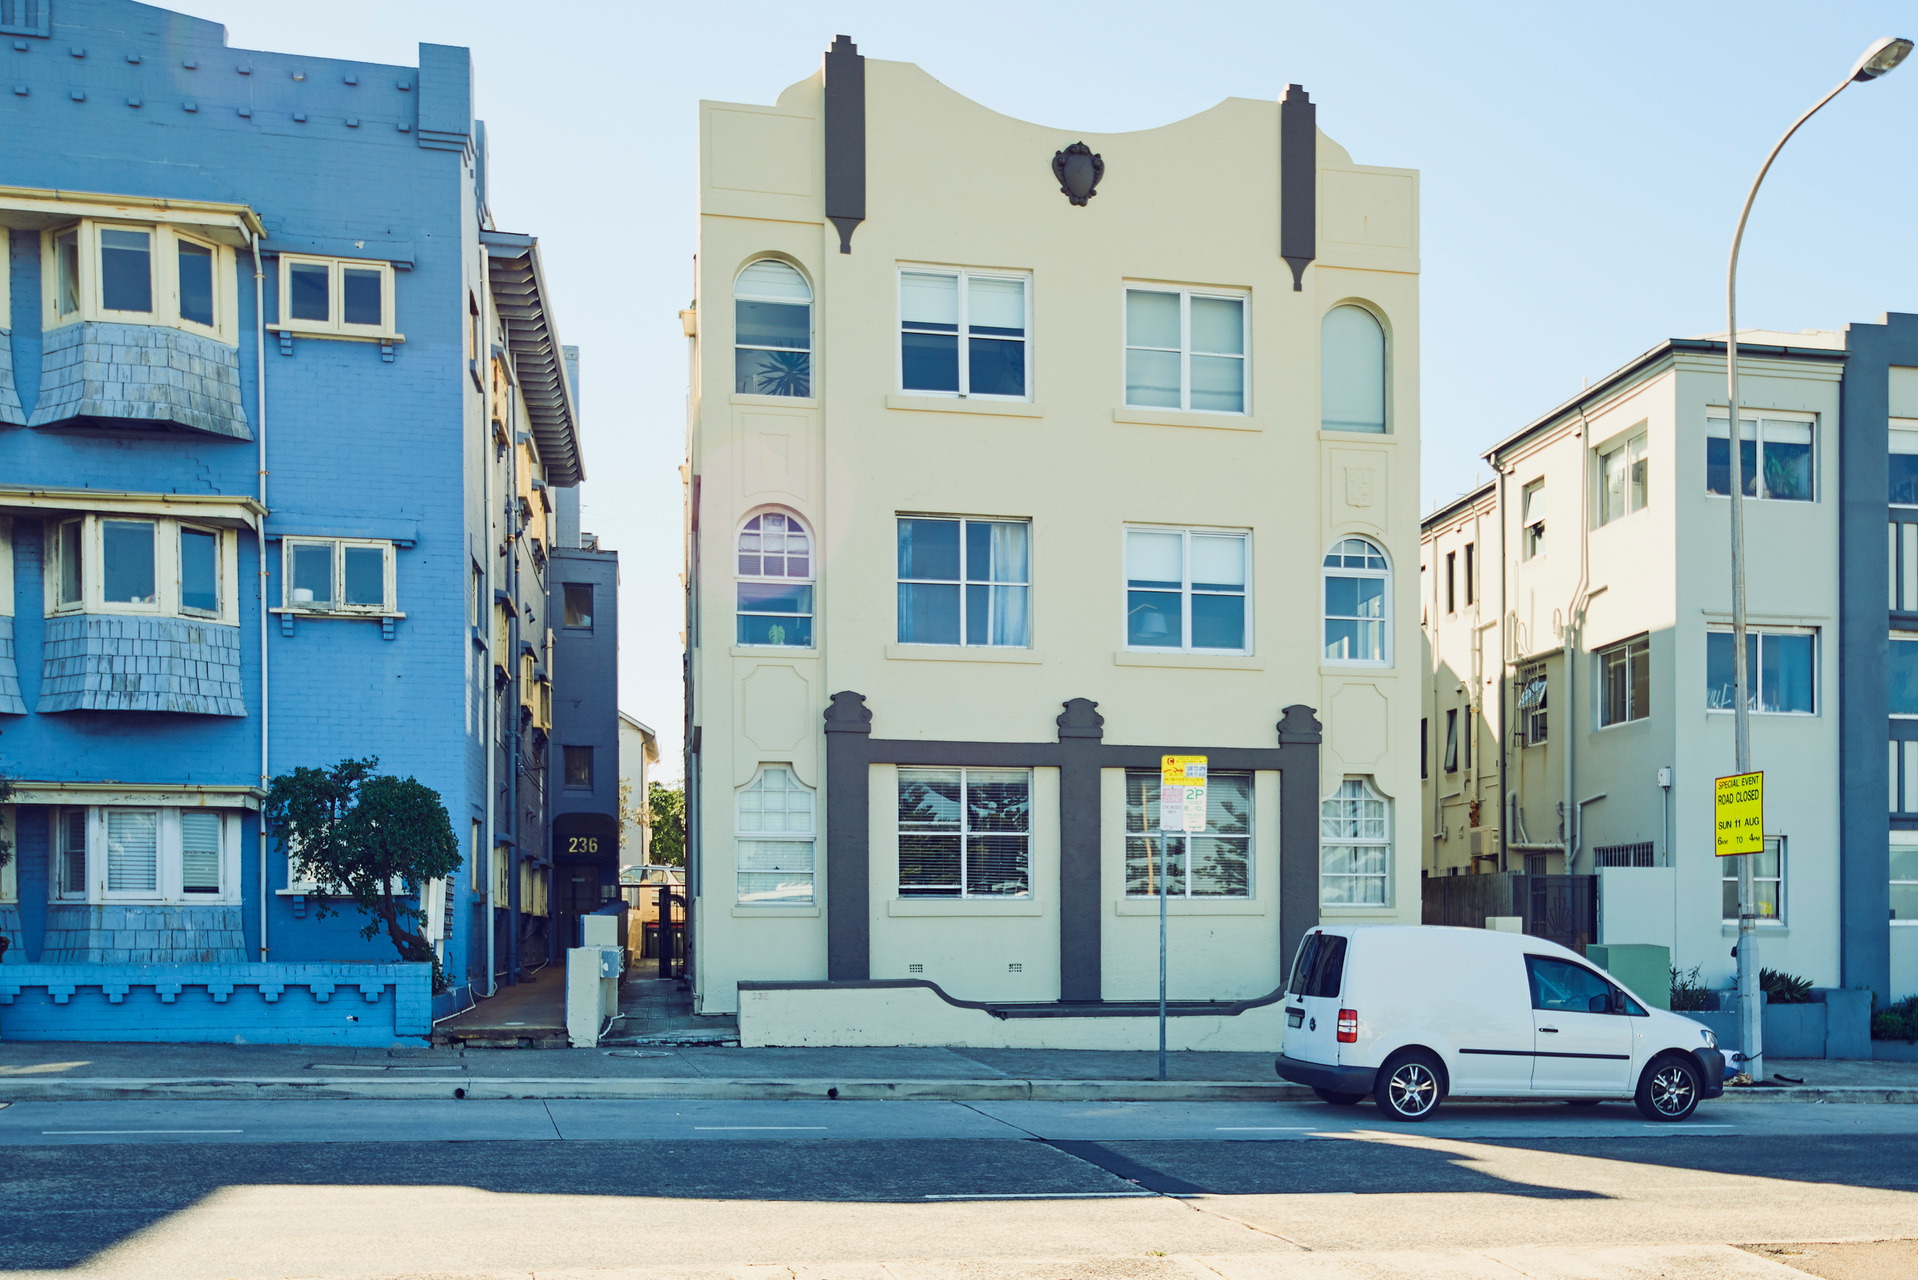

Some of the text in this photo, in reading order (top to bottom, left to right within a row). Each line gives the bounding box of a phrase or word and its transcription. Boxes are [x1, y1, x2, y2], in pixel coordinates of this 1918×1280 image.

[1718, 776, 1760, 790] SPECIAL EVENT
[1186, 790, 1204, 800] 2P
[1718, 789, 1759, 805] ROAD CLOSED
[1718, 817, 1760, 830] SUN 11 AUG
[568, 837, 598, 853] 236
